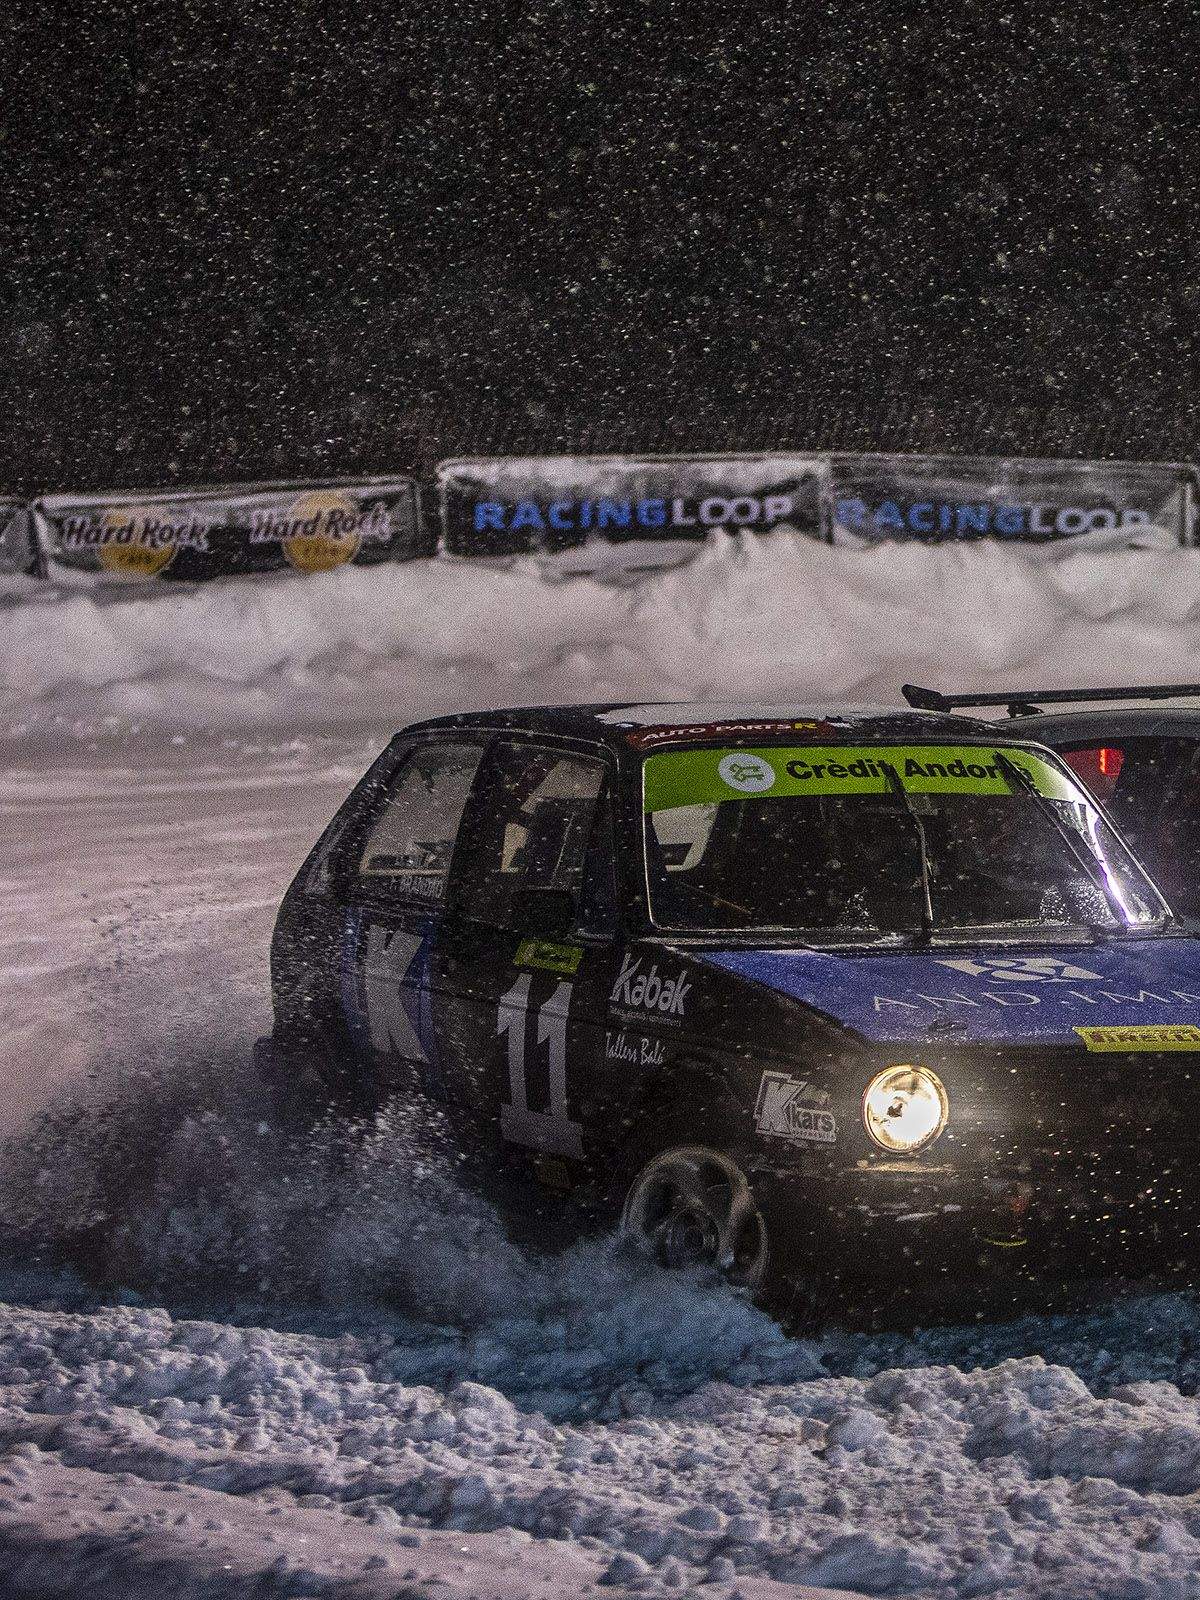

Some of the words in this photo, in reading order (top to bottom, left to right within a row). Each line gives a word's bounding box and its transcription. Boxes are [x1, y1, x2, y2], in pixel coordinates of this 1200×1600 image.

[253, 508, 322, 539] Hard
[325, 503, 389, 540] Rock
[473, 496, 794, 530] RACINGLOOP
[65, 514, 136, 545] Hard
[140, 514, 208, 549] Rock
[641, 728, 706, 742] AUTO
[787, 759, 892, 779] Crèdit
[609, 952, 693, 1015] Kabak
[496, 972, 584, 1160] 11
